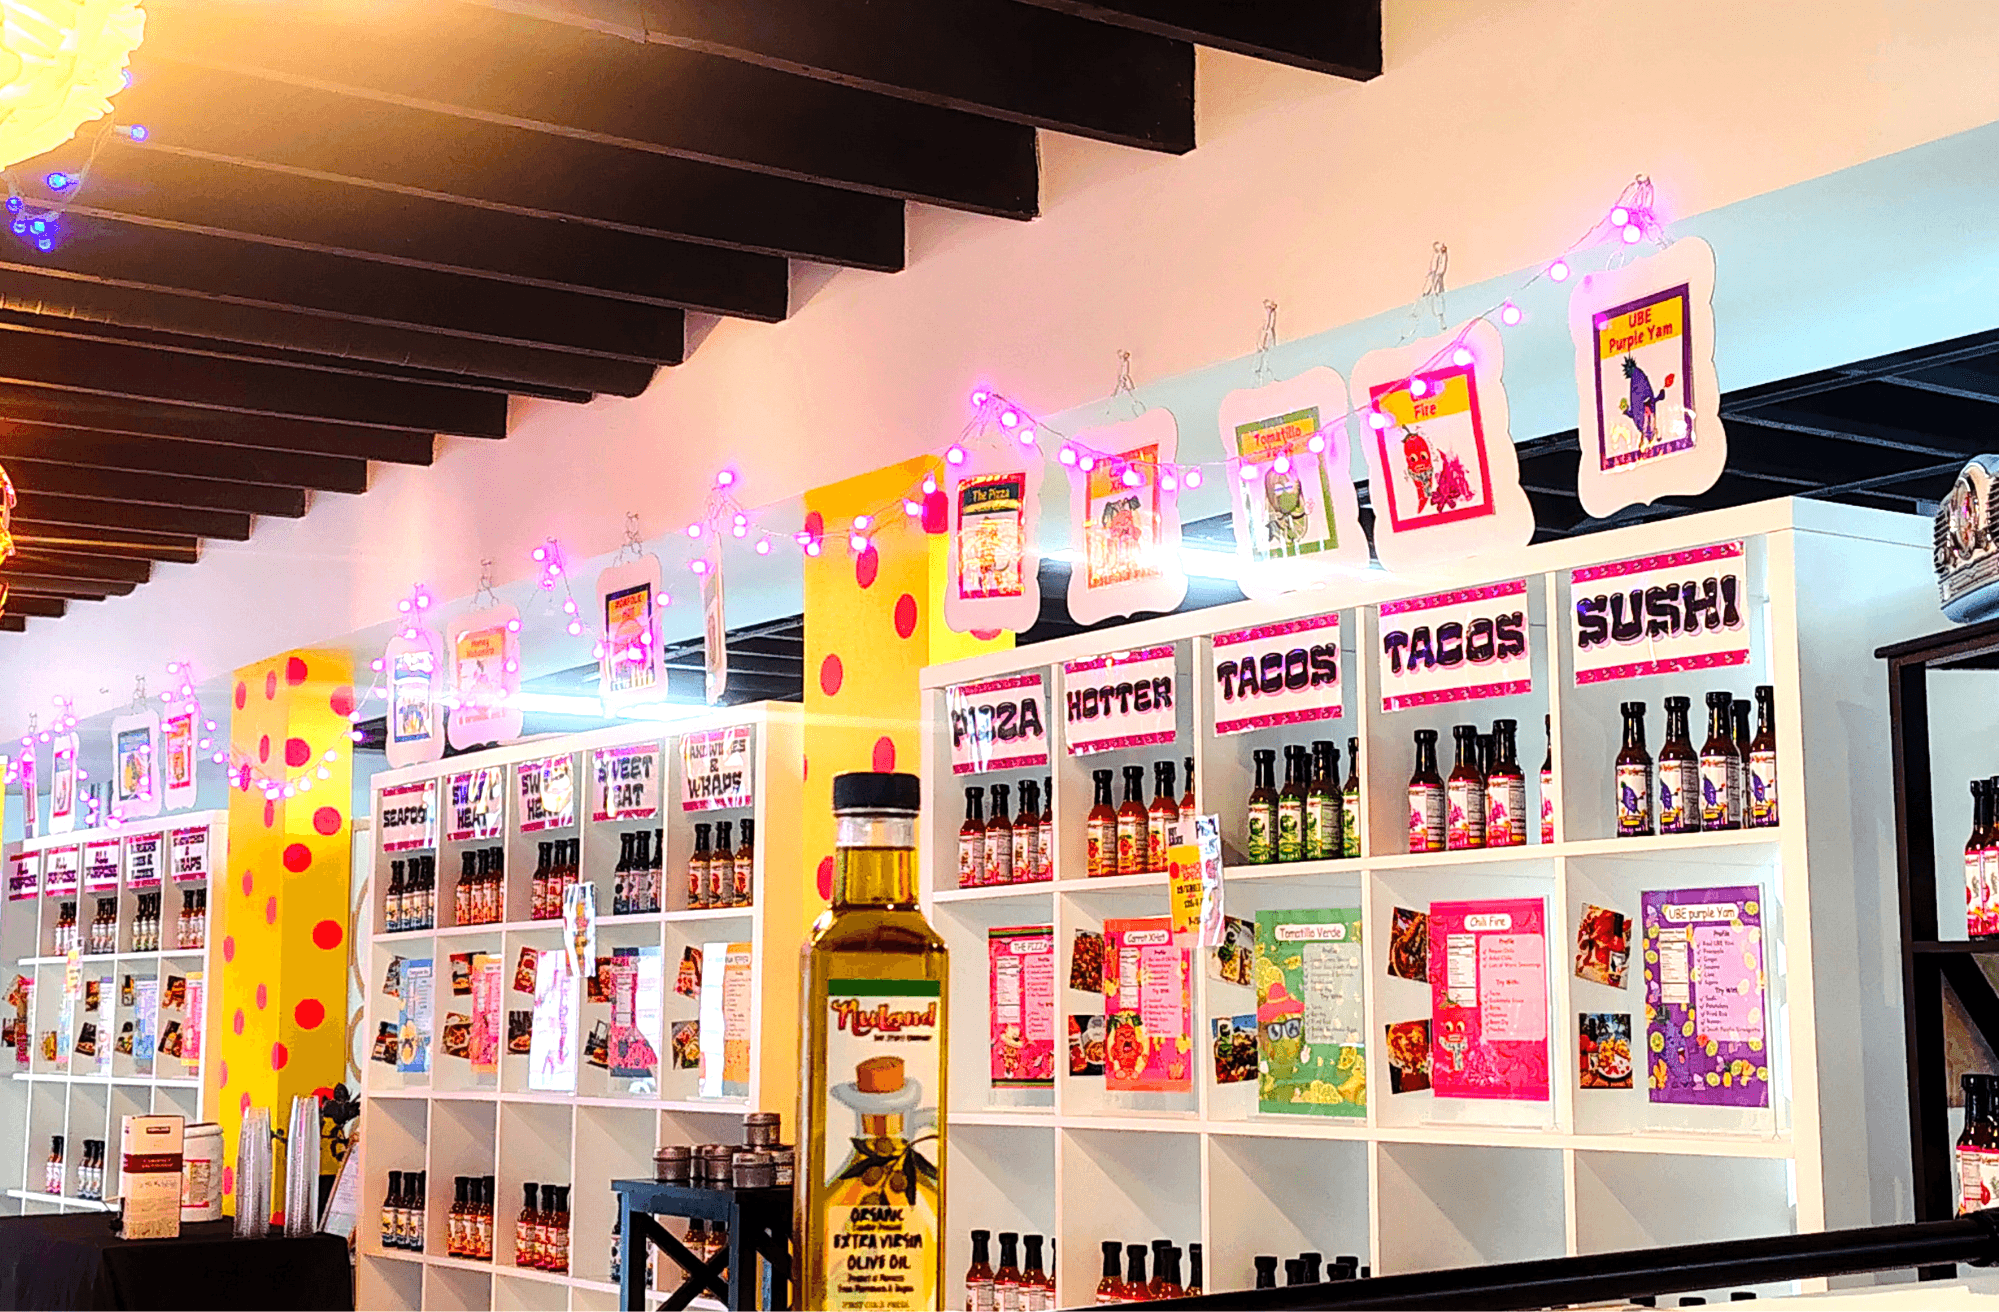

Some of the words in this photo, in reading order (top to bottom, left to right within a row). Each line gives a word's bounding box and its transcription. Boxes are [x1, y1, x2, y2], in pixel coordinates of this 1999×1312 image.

[1628, 308, 1652, 328] UBE
[1609, 331, 1644, 353] Purple
[1648, 322, 1673, 340] Yam
[1414, 403, 1437, 420] Fire
[973, 489, 987, 502] The
[1576, 575, 1741, 649] SUSHI
[1383, 612, 1527, 674] TACOS
[1216, 643, 1338, 700] TACOS
[1066, 676, 1173, 722] HOTTER
[710, 758, 719, 773] &
[688, 771, 743, 799] WRAPS
[383, 803, 434, 829] SEAFOO
[1470, 916, 1488, 927] Chili
[1489, 916, 1506, 927] Fire
[1668, 907, 1687, 919] UBE
[1688, 907, 1715, 922] purple
[1716, 906, 1735, 918] Yam
[1280, 927, 1315, 938] Tomatillo
[1316, 926, 1341, 938] Verde
[1014, 942, 1026, 951] THE
[851, 1207, 904, 1222] ORGANIC
[834, 1233, 877, 1249] EXTRA
[879, 1232, 923, 1249] VIRGIN
[847, 1254, 885, 1270] OLIVE
[889, 1254, 911, 1270] OIL
